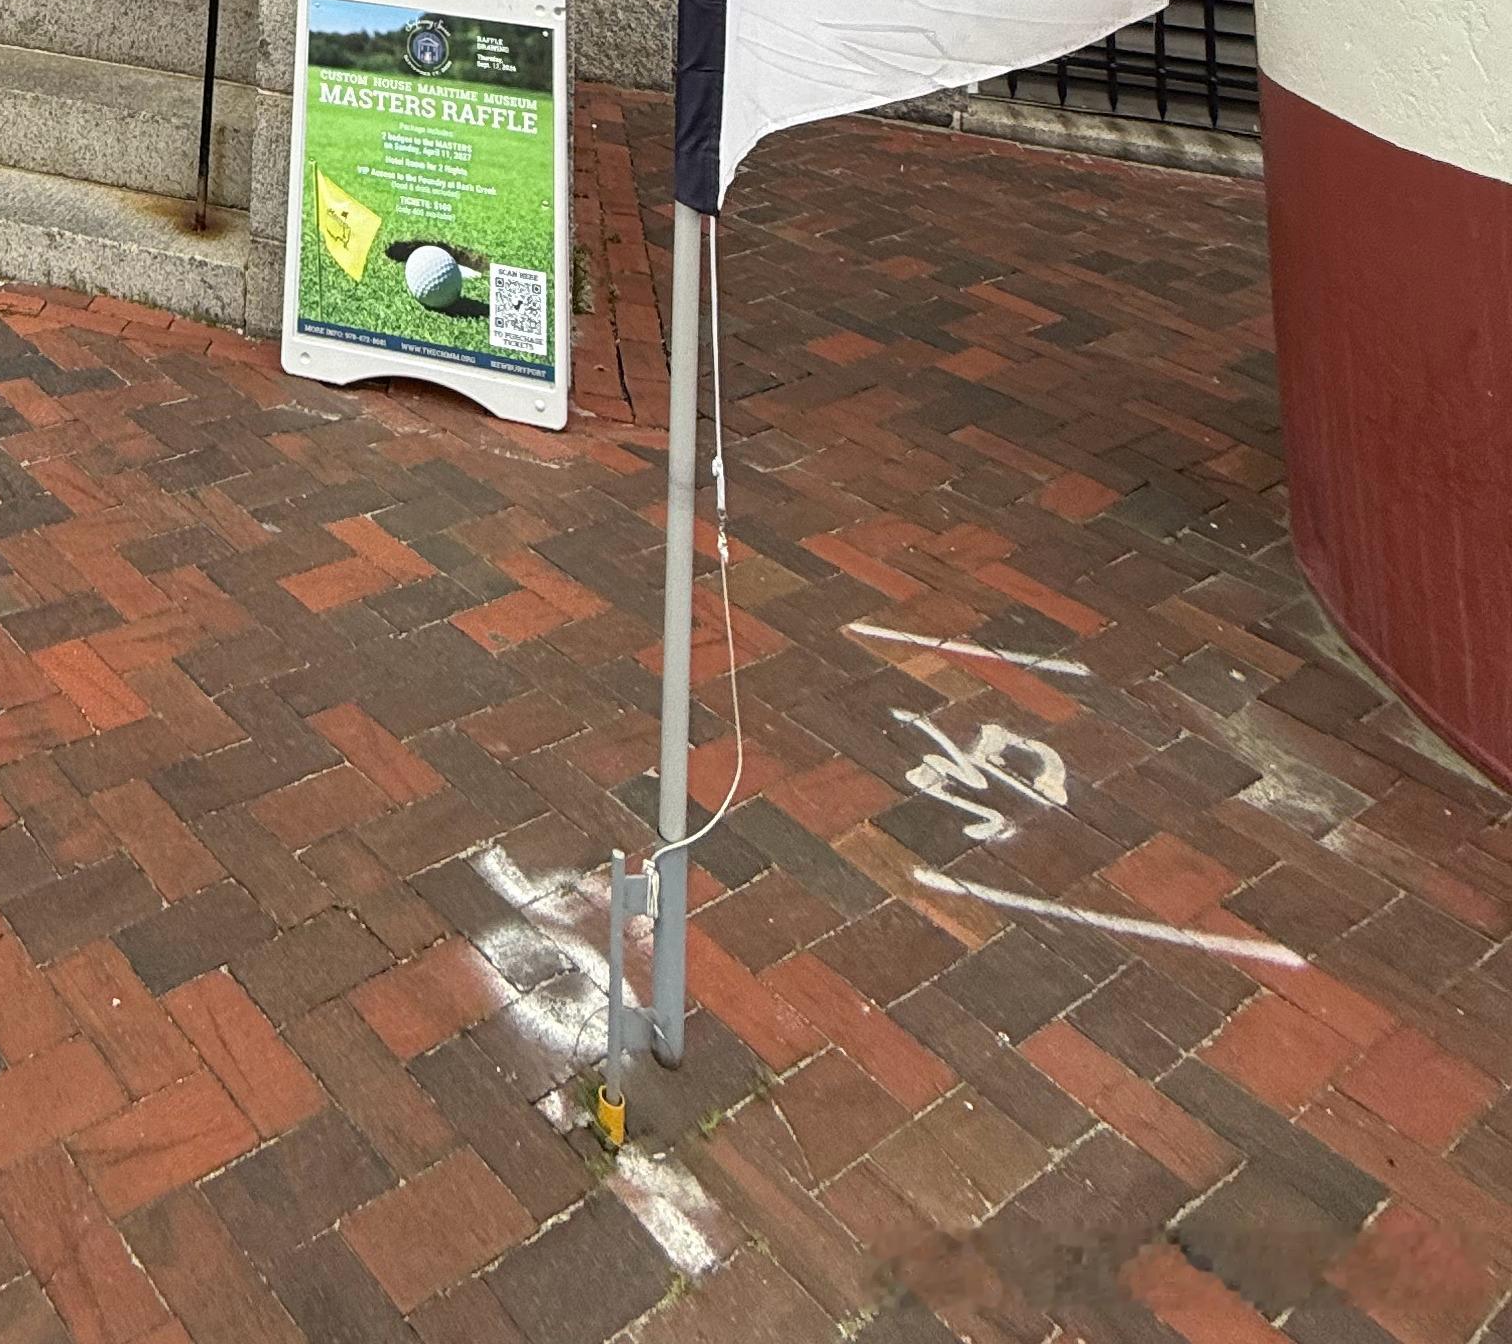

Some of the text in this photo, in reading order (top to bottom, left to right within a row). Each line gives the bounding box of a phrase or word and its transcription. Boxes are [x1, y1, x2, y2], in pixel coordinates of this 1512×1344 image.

[477, 36, 503, 46] RAFFLE
[477, 43, 509, 53] DRAWING
[320, 70, 537, 110] CUSTOM HOUSE MARITIME MUSEUM
[319, 82, 538, 135] MASTERS RAFFLE
[435, 140, 472, 154] MASTERS
[498, 268, 538, 281] SCAN HERE
[494, 330, 544, 345] TO PURCHASE
